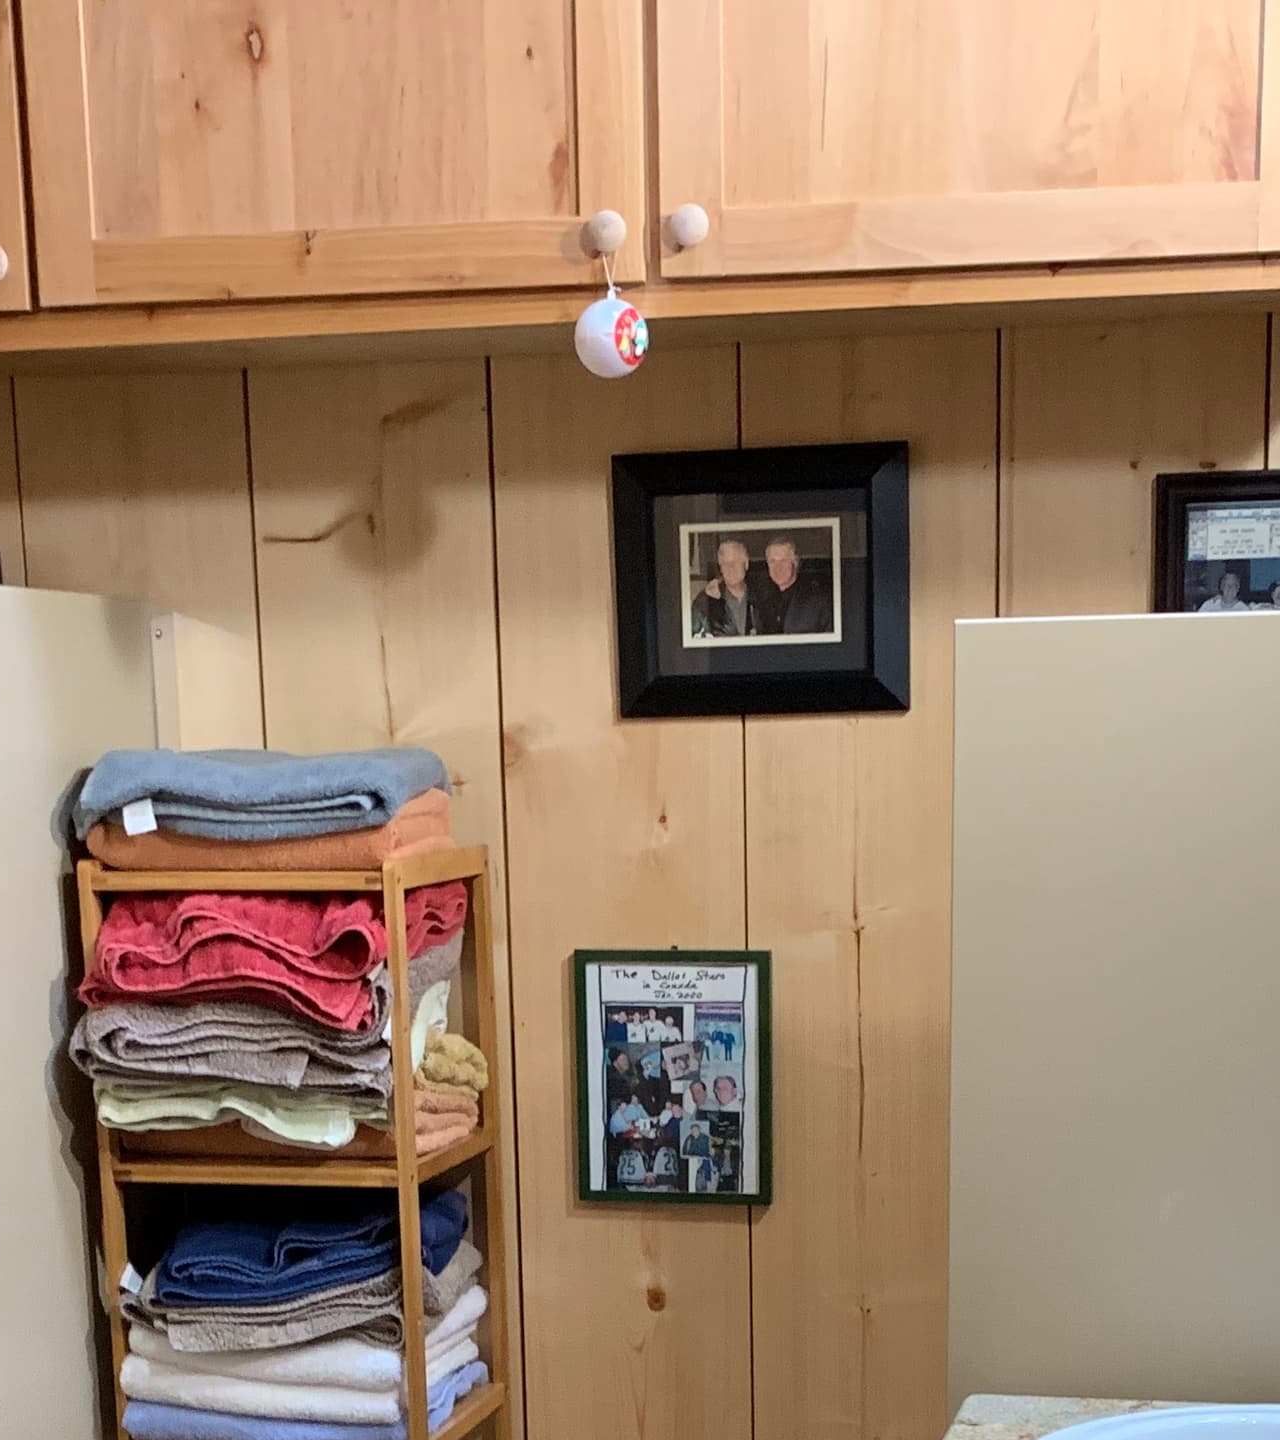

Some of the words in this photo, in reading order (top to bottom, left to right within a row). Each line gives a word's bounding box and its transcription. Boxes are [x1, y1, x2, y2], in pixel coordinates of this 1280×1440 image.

[611, 968, 638, 979] The
[694, 970, 726, 982] Stars
[659, 980, 698, 989] Canada
